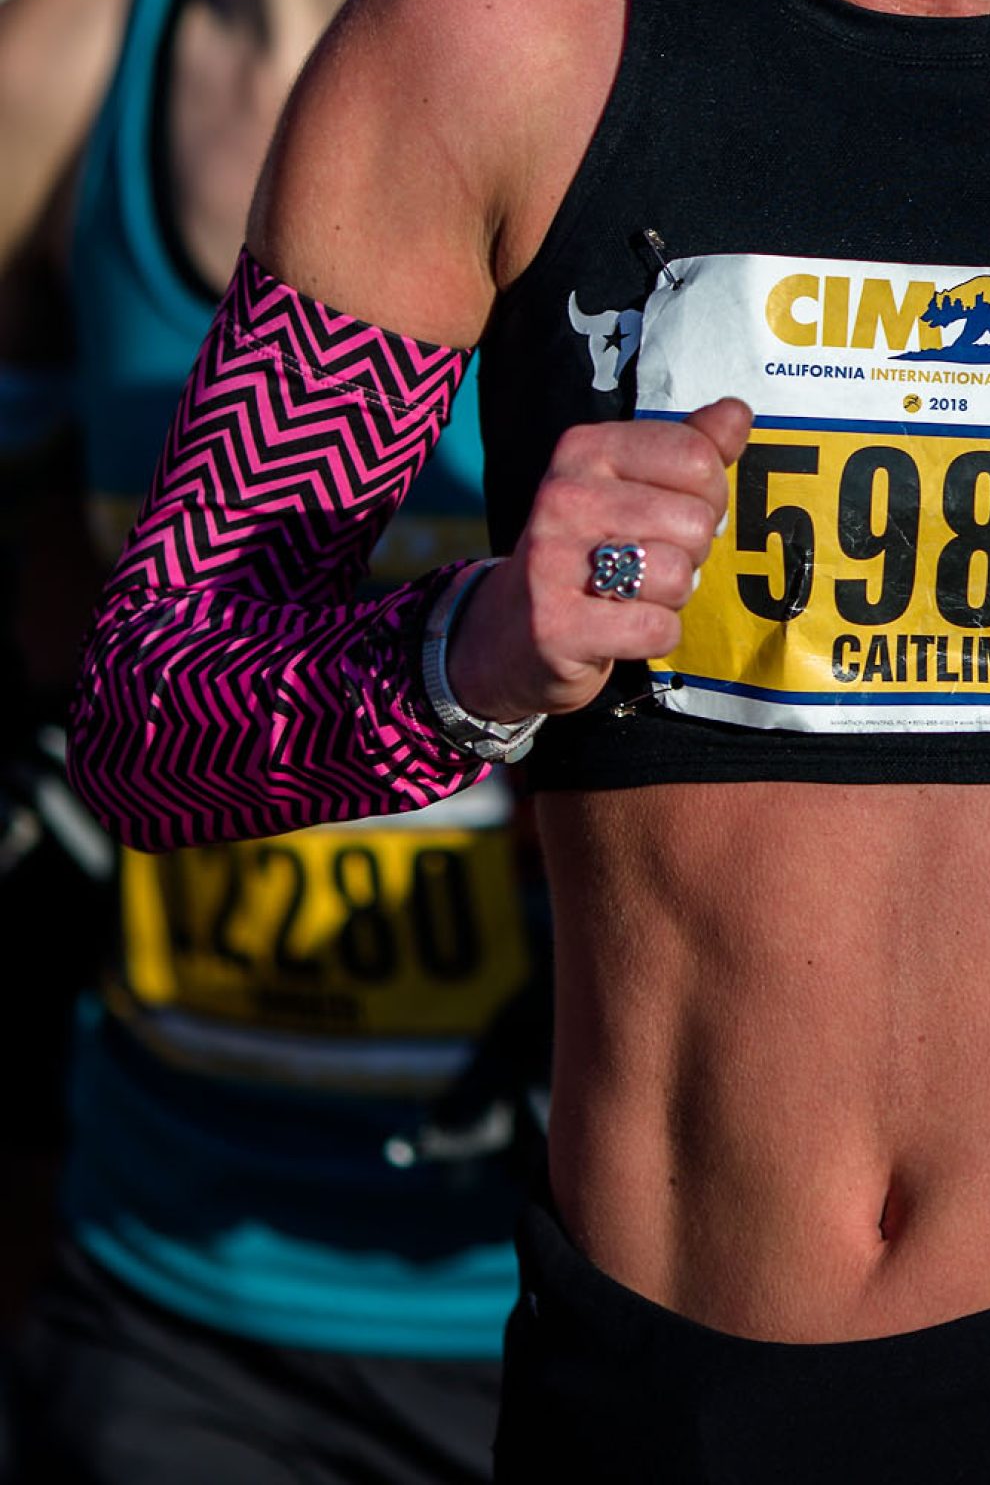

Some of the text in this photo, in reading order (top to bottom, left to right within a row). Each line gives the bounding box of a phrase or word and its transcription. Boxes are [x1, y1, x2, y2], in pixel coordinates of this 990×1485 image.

[765, 274, 943, 351] CIM
[765, 363, 865, 380] CALIFORNIA
[929, 398, 969, 412] 2018
